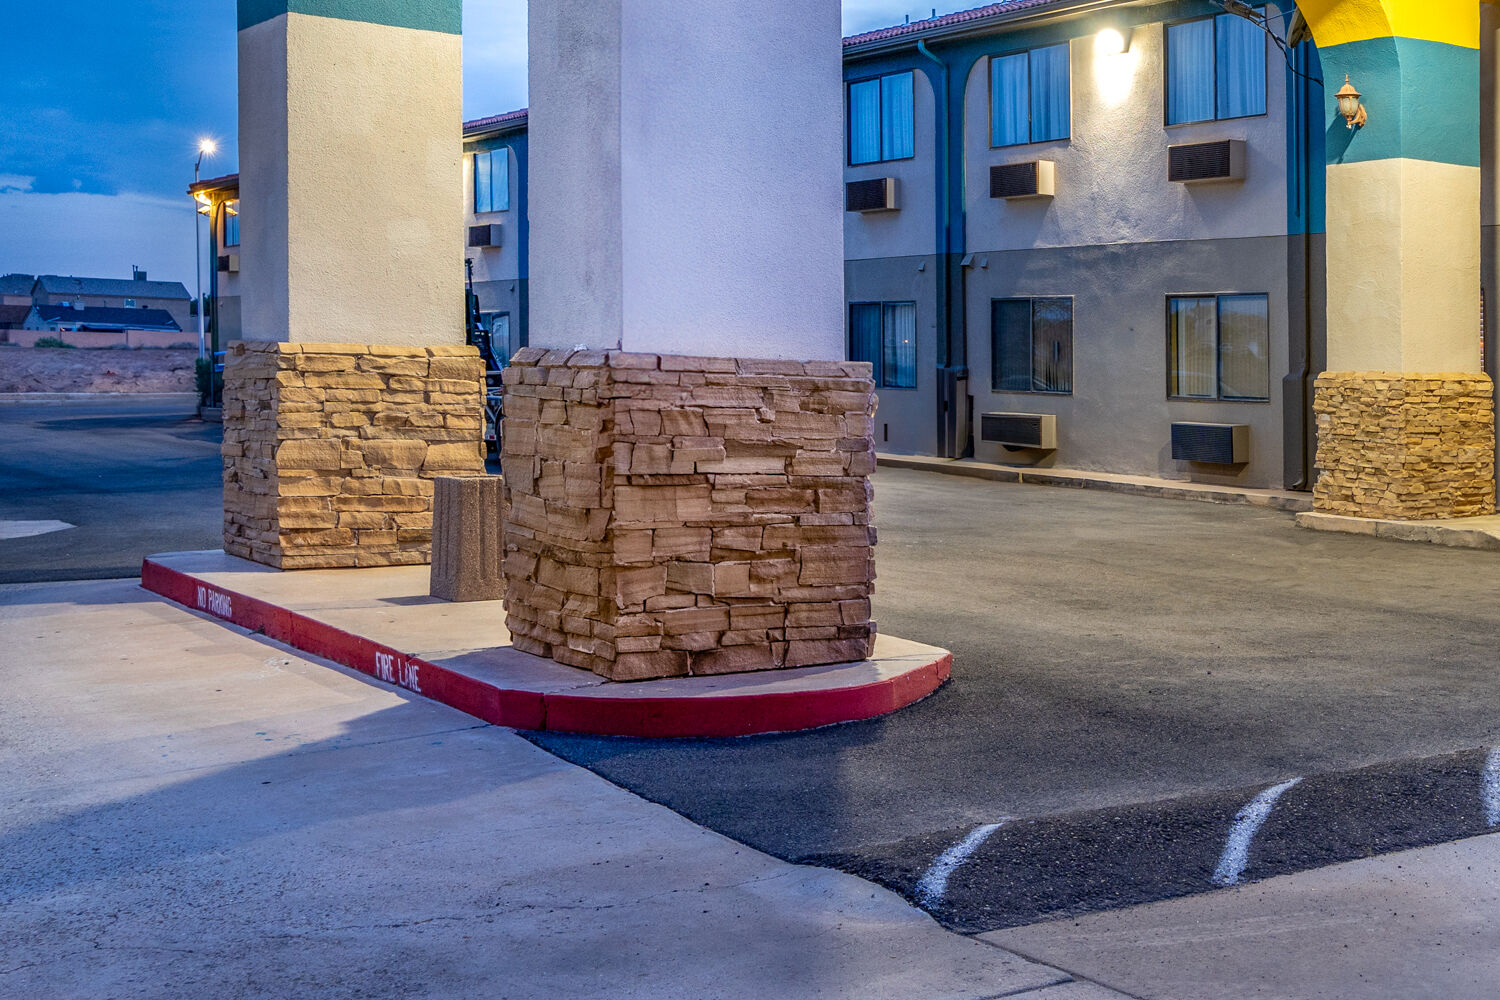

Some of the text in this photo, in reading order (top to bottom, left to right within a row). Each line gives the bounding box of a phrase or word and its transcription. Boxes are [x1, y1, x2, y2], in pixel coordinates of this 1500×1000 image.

[197, 585, 233, 617] NO PARKING
[376, 651, 421, 692] FIRE LANE
